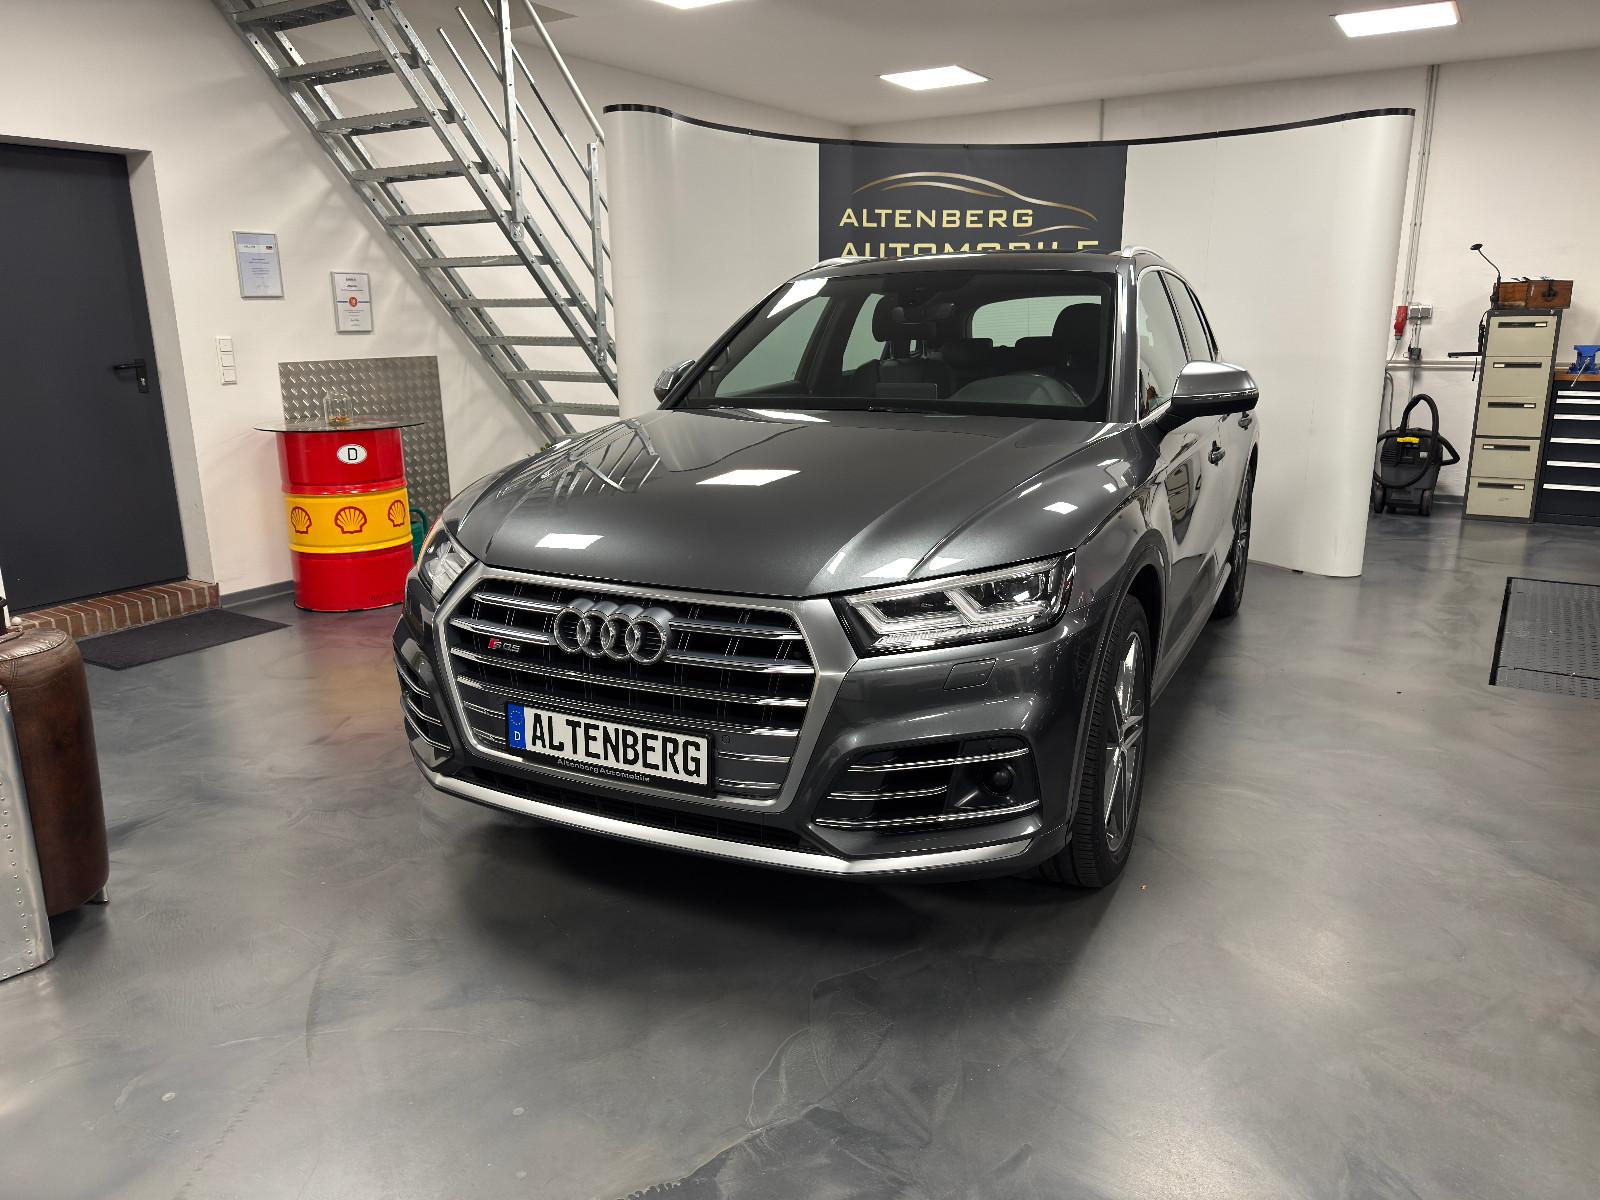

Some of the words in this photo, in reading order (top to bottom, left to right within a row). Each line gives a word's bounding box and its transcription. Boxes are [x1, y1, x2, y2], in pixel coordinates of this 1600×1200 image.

[839, 207, 1034, 228] ALTENBERG
[348, 447, 358, 461] D
[514, 730, 521, 741] D
[531, 712, 701, 778] ALTENBERG
[557, 759, 599, 774] Altenberg
[599, 768, 650, 782] Automobile
